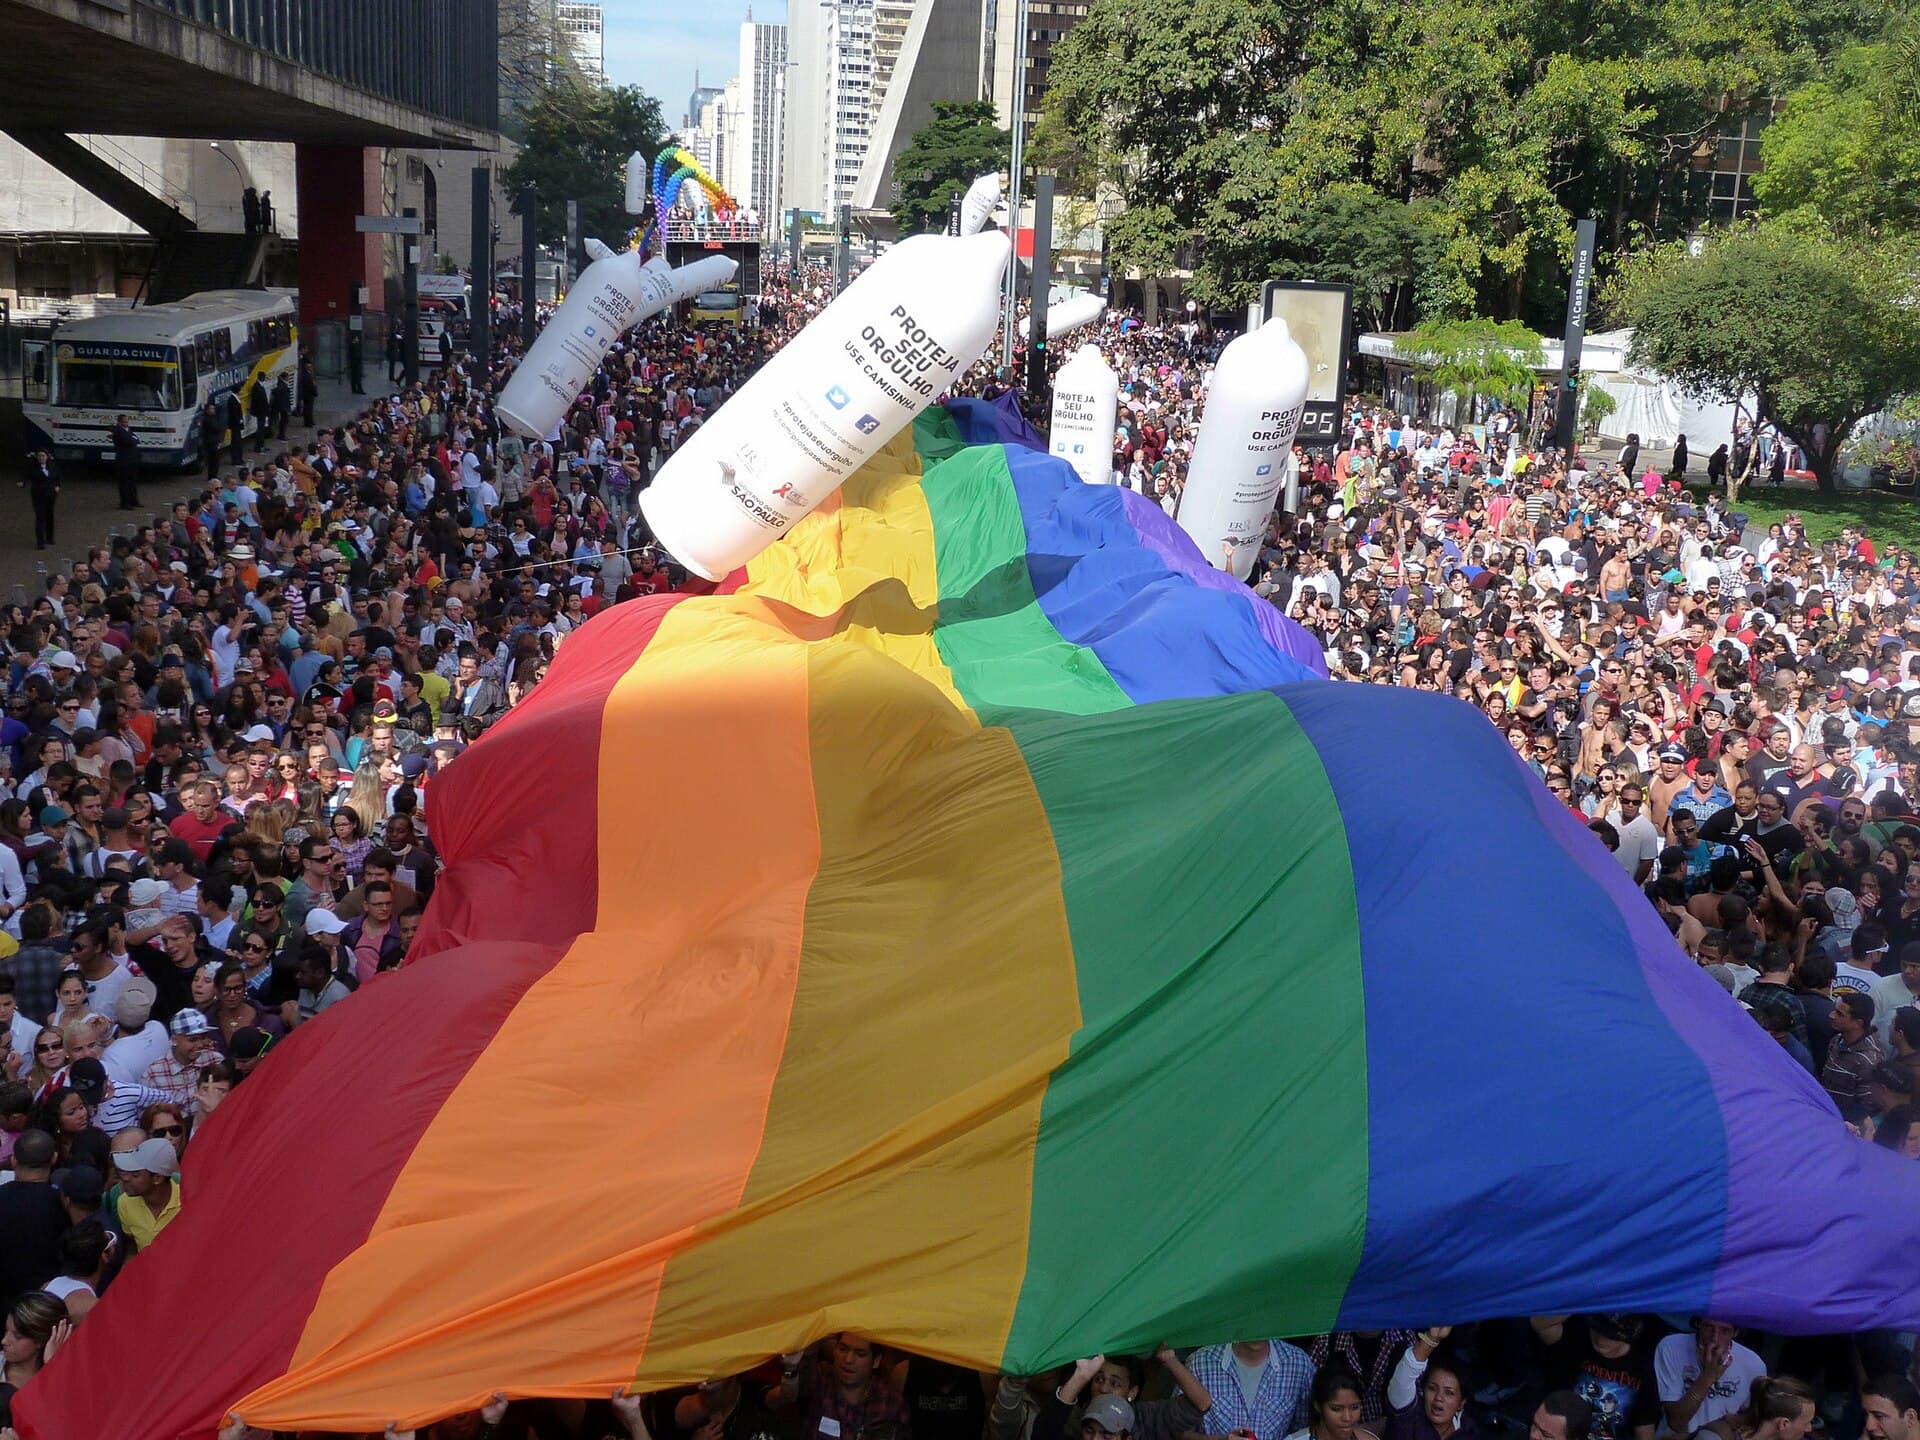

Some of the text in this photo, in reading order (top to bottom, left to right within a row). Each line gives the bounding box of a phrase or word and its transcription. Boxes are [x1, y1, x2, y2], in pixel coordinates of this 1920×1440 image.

[1575, 249, 1587, 287] Branca
[609, 298, 627, 314] SEU
[890, 304, 960, 373] PROTEJA
[77, 347, 162, 359] GUARDA CIVIL
[844, 340, 866, 366] USE
[861, 325, 934, 398] ORGULHO.
[894, 339, 933, 372] SEU
[1057, 392, 1095, 403] PROTEJA
[1064, 402, 1082, 411] SEU
[1055, 409, 1096, 422] ORGULHO.
[1248, 444, 1266, 452] USE
[752, 506, 785, 528] PAULO
